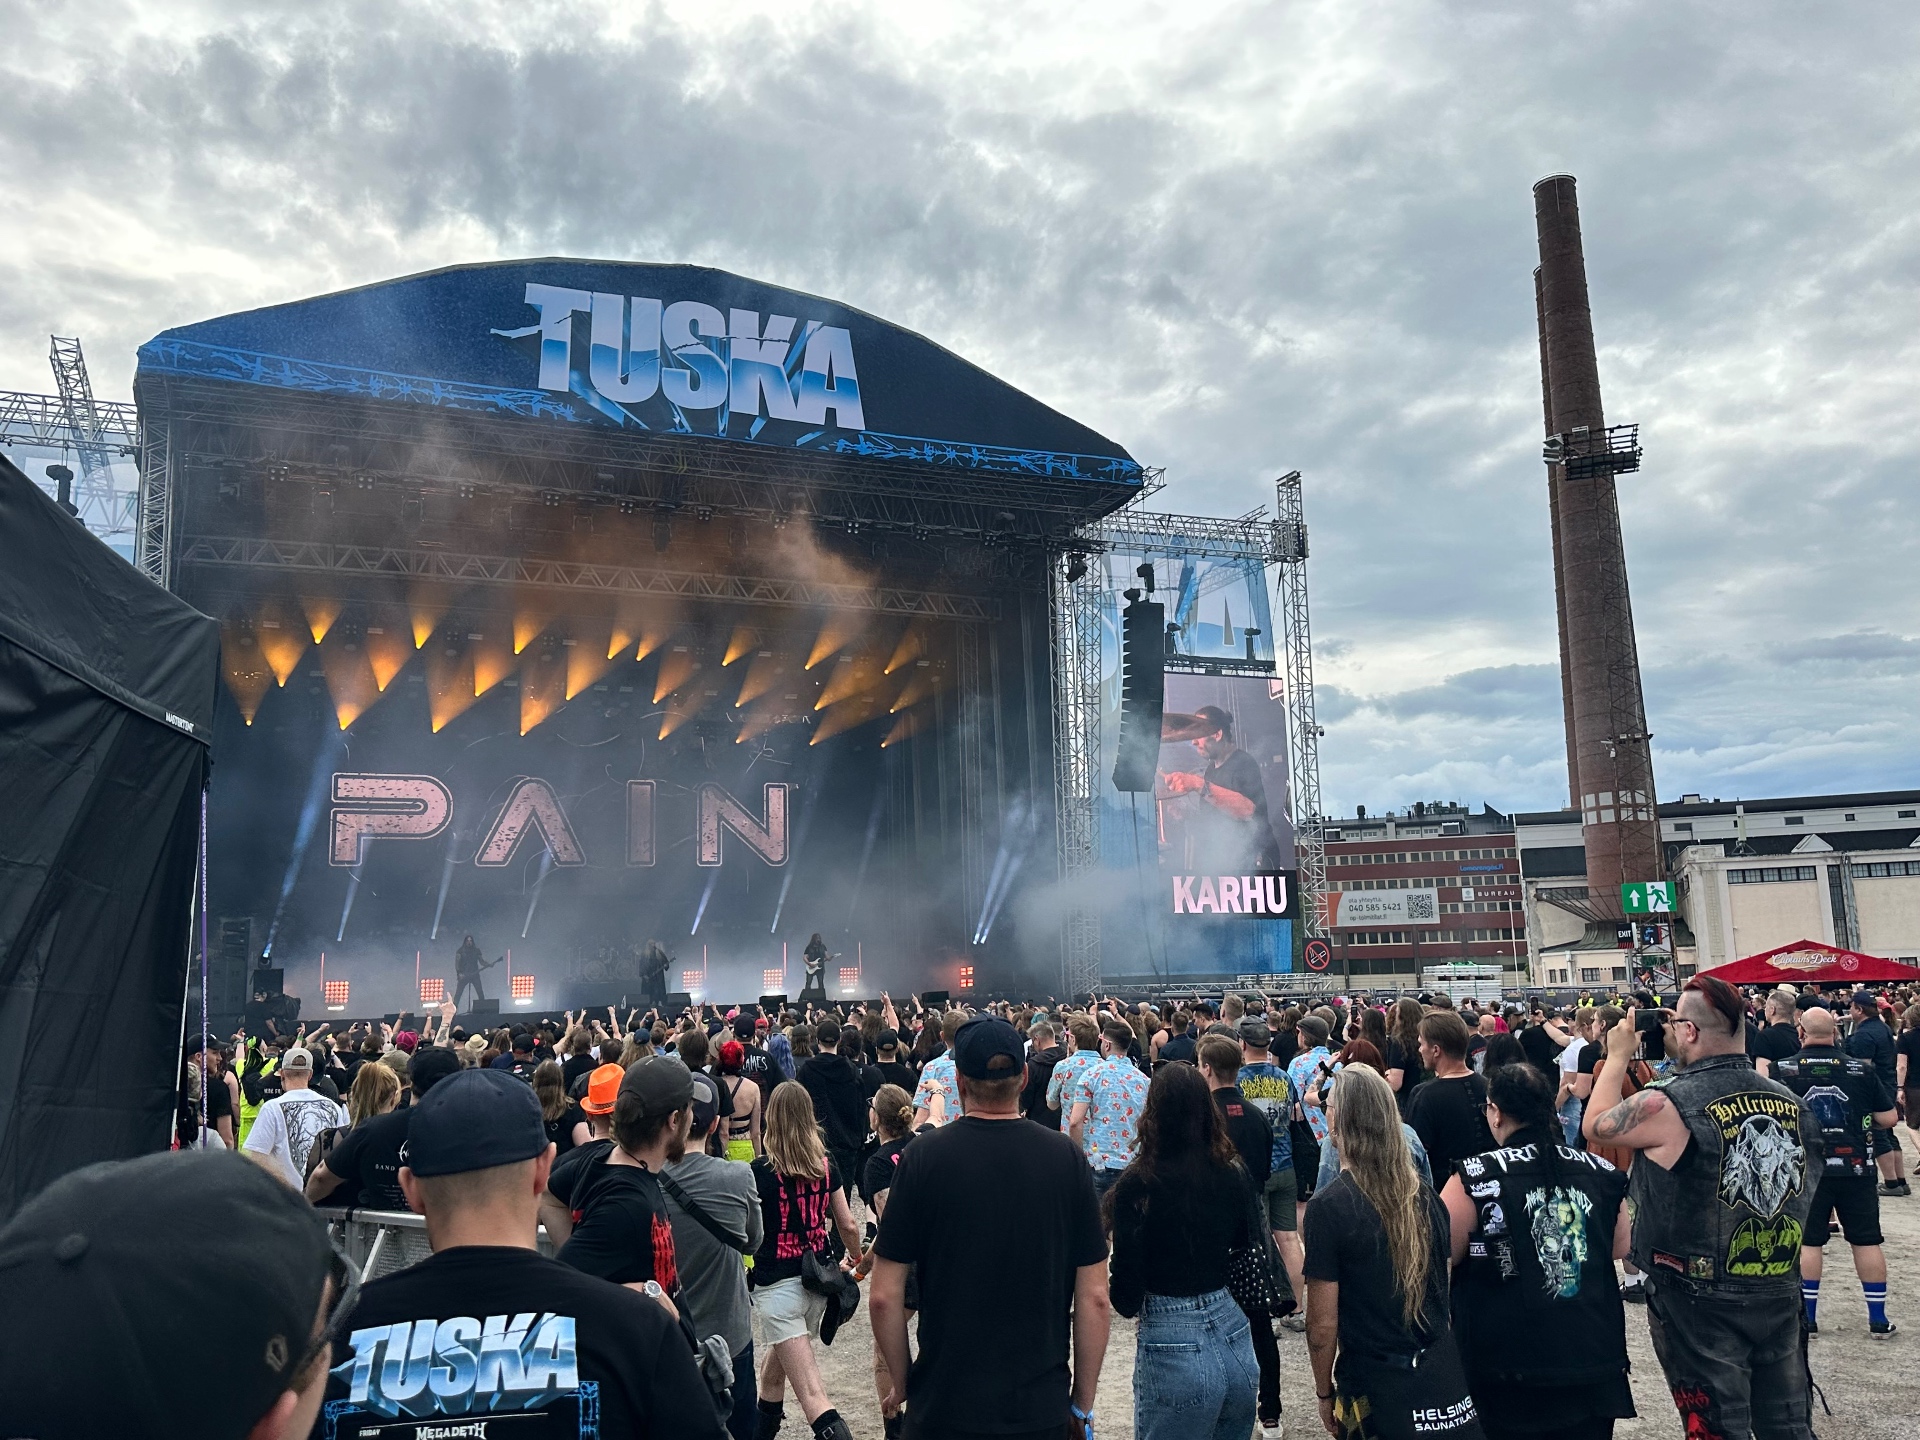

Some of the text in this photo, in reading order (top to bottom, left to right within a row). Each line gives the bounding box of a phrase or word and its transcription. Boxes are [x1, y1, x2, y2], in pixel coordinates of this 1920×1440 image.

[525, 283, 866, 431] TUSKA
[329, 772, 789, 867] PAIN
[1172, 875, 1288, 914] KARHU
[1348, 902, 1402, 912] 040 585 5421
[1617, 930, 1632, 938] EXIT
[1810, 953, 1838, 965] Deck
[1710, 1095, 1797, 1127] Hellripper
[349, 1312, 580, 1410] TUSKA
[359, 1428, 381, 1437] FRIDAY
[415, 1422, 488, 1440] MEGADETH
